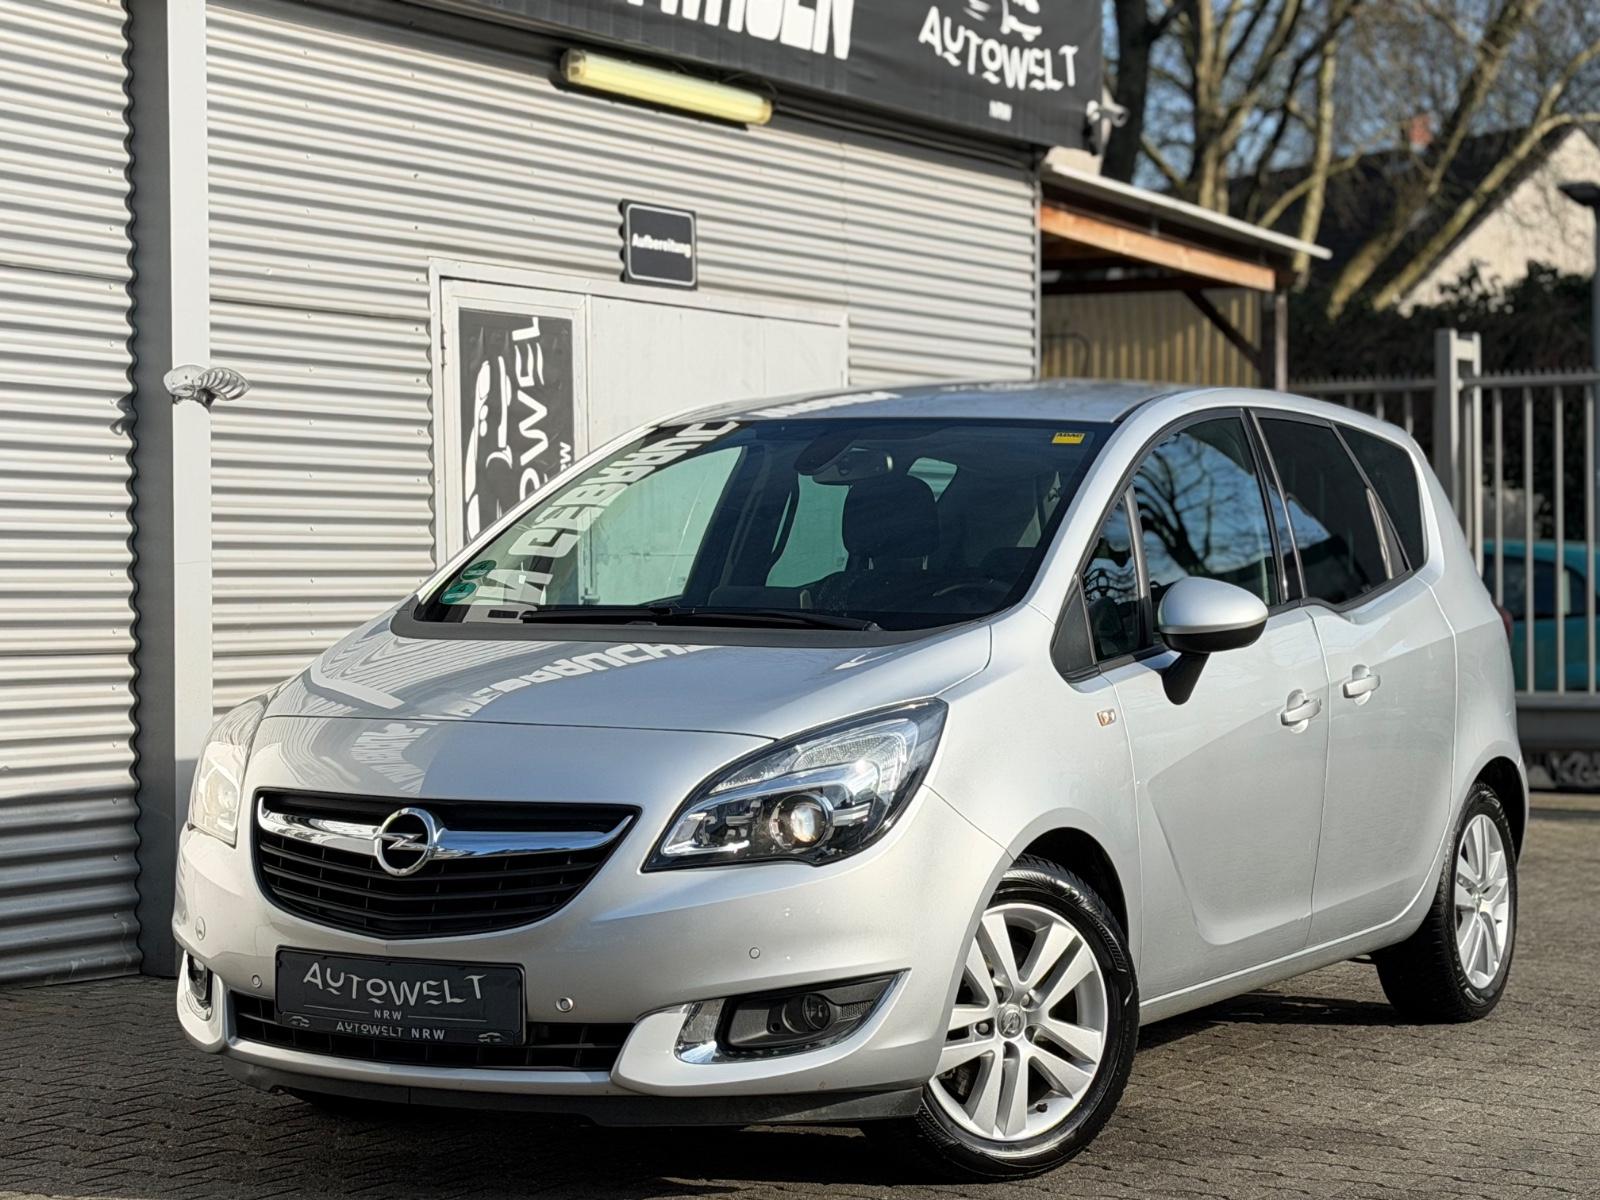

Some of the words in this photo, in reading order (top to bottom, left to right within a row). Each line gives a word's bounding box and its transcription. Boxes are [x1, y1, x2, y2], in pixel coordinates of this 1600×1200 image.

[918, 6, 1079, 91] AUTOWELT
[303, 962, 488, 1007] AUTOWELT
[336, 1020, 404, 1038] AUTOWELT
[411, 1028, 446, 1041] NRW
[374, 1009, 403, 1021] NRW
